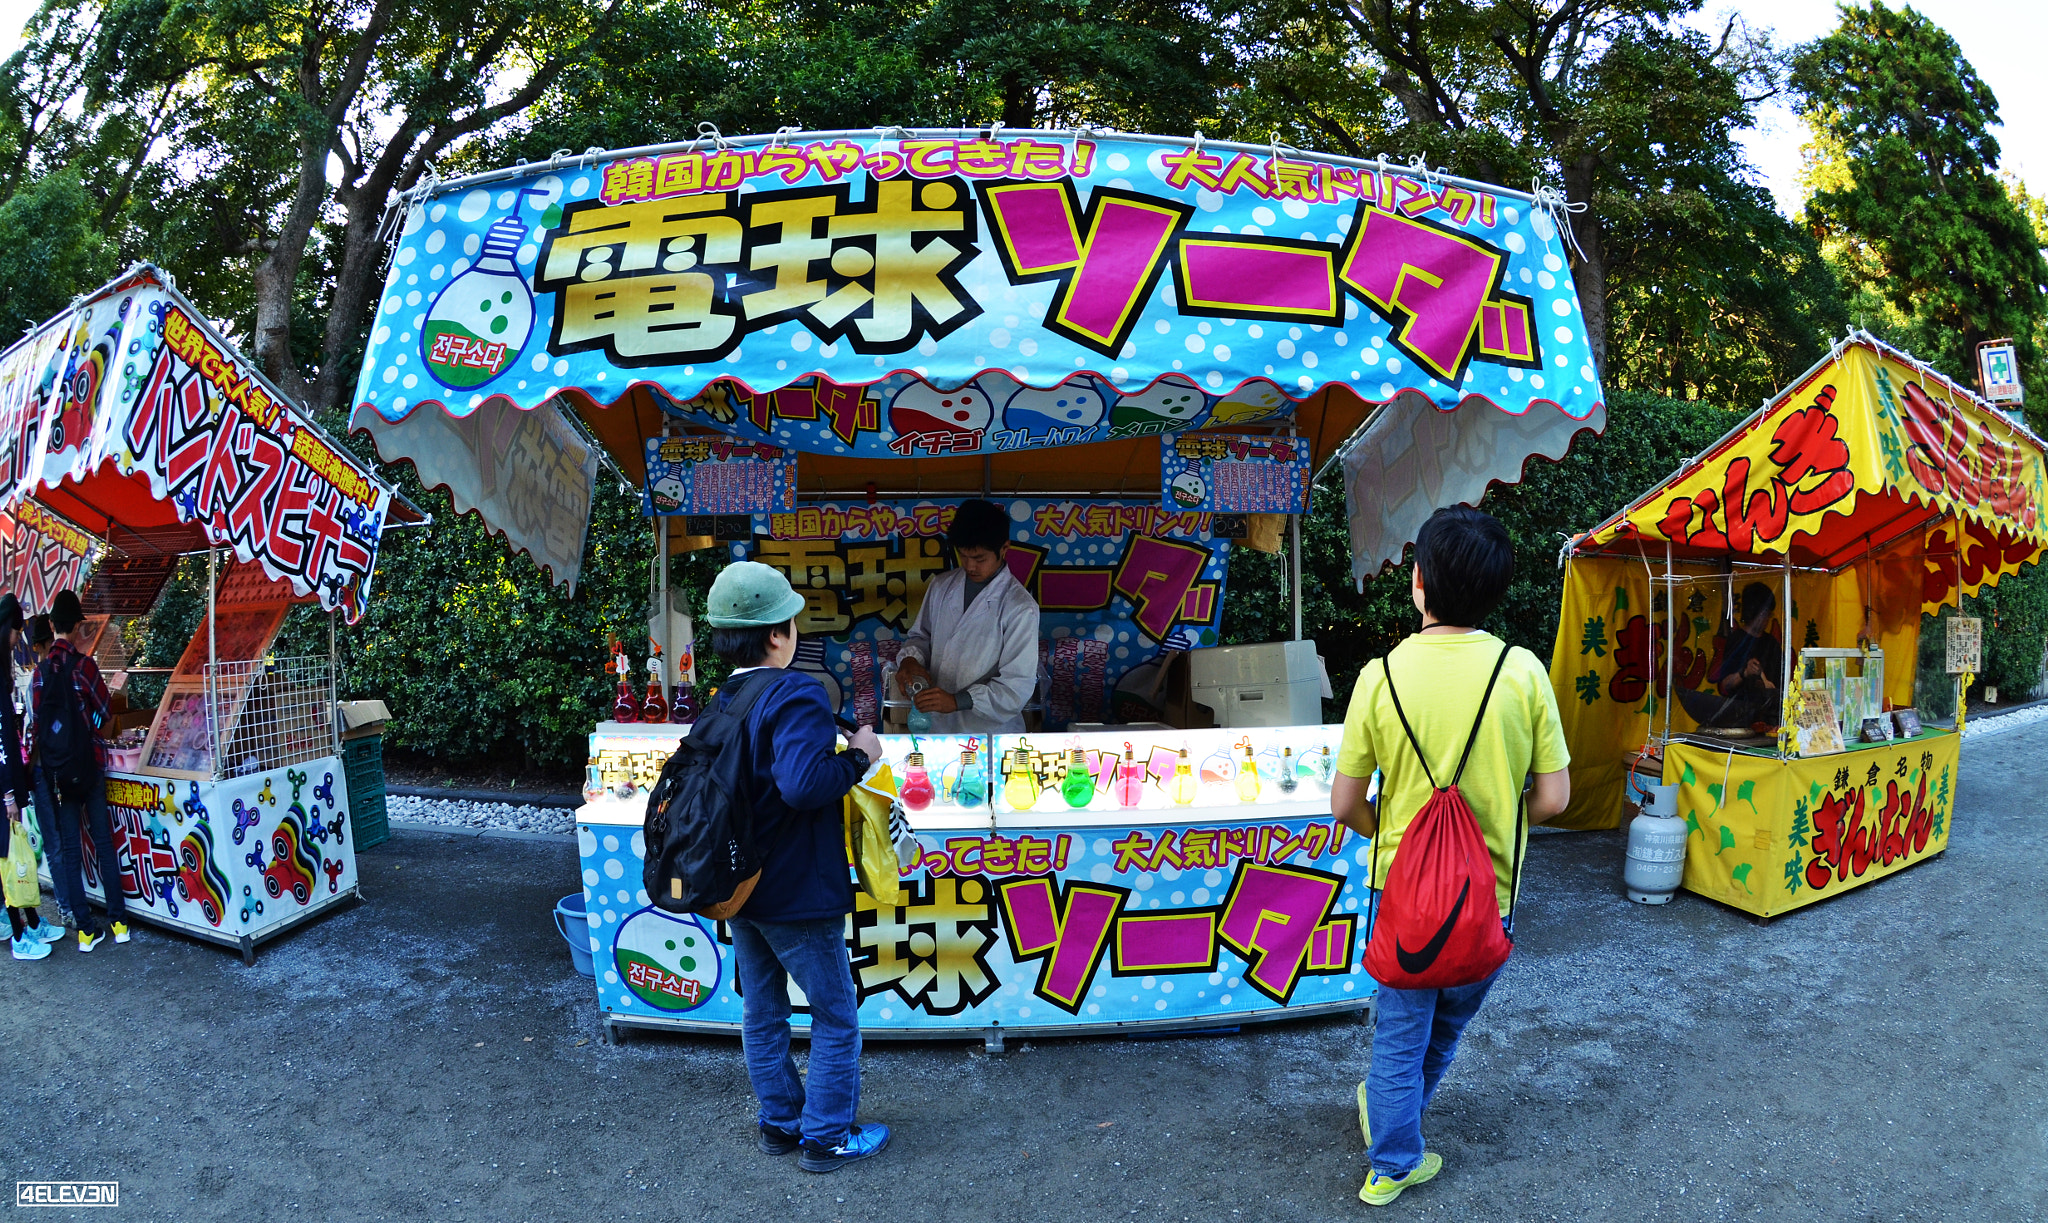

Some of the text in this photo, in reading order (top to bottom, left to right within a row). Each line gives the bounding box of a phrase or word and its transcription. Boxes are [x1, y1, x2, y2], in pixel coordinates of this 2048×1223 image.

[607, 141, 1495, 225] 韓国からやってきた! 大人気ドリンク!
[543, 181, 1533, 380] 電球ソーダ
[165, 308, 280, 428] 世界で大人気!
[430, 333, 504, 373] 전구소다
[659, 441, 783, 463] 電球ソーダ
[889, 429, 985, 455] イチゴ
[1107, 419, 1196, 440] メロン
[1175, 438, 1298, 464] 電球ソーダ
[1874, 365, 1905, 482] 美味
[1899, 380, 2037, 532] ぎんなん
[130, 349, 370, 581] ハンドスピナー
[293, 429, 379, 509] 話題沸騰中!
[1576, 616, 1607, 705] 美味
[1834, 751, 1933, 791] 鎌倉名物
[1932, 764, 1949, 842] 美味
[1113, 824, 1345, 872] 大人気ドリンク!
[1785, 796, 1810, 895] 美味
[1806, 771, 1934, 889] ぎんなん
[628, 961, 699, 1004] 전구소다
